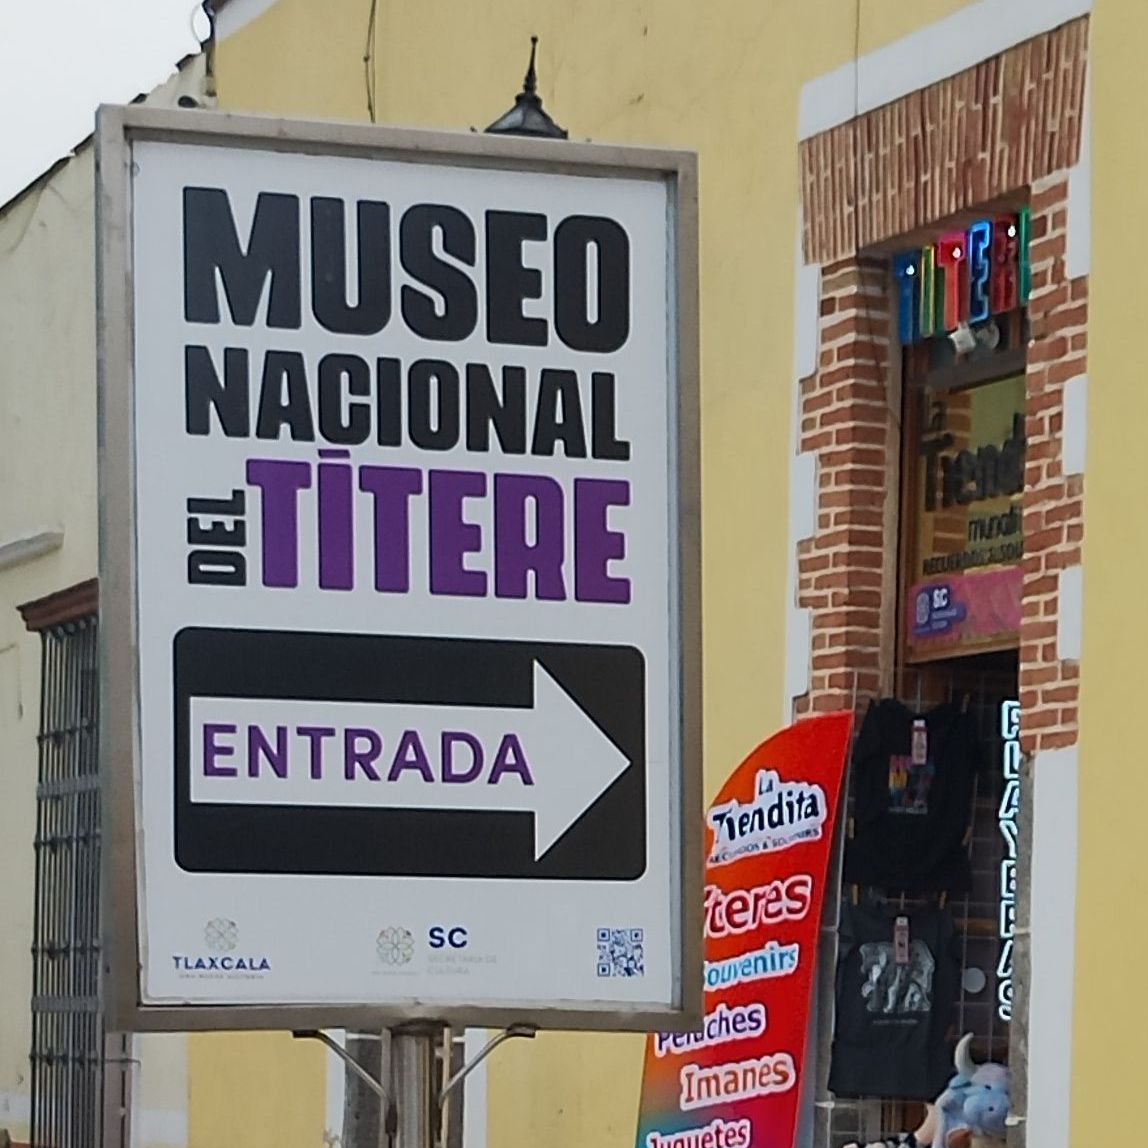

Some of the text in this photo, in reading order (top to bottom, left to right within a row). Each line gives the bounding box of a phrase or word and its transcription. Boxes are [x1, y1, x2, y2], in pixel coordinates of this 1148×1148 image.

[182, 186, 630, 354] MUSEO
[184, 344, 631, 462] NACIONAL
[921, 411, 1025, 512] Tiend
[186, 448, 631, 605] DEL TÍTERE
[202, 722, 535, 786] ENTRADA
[712, 789, 820, 843] Tiendita
[704, 879, 809, 933] teres
[172, 955, 271, 970] TLAXCALA
[428, 926, 467, 948] SC
[706, 946, 797, 986] ouvenirs
[684, 1060, 790, 1103] Imanes
